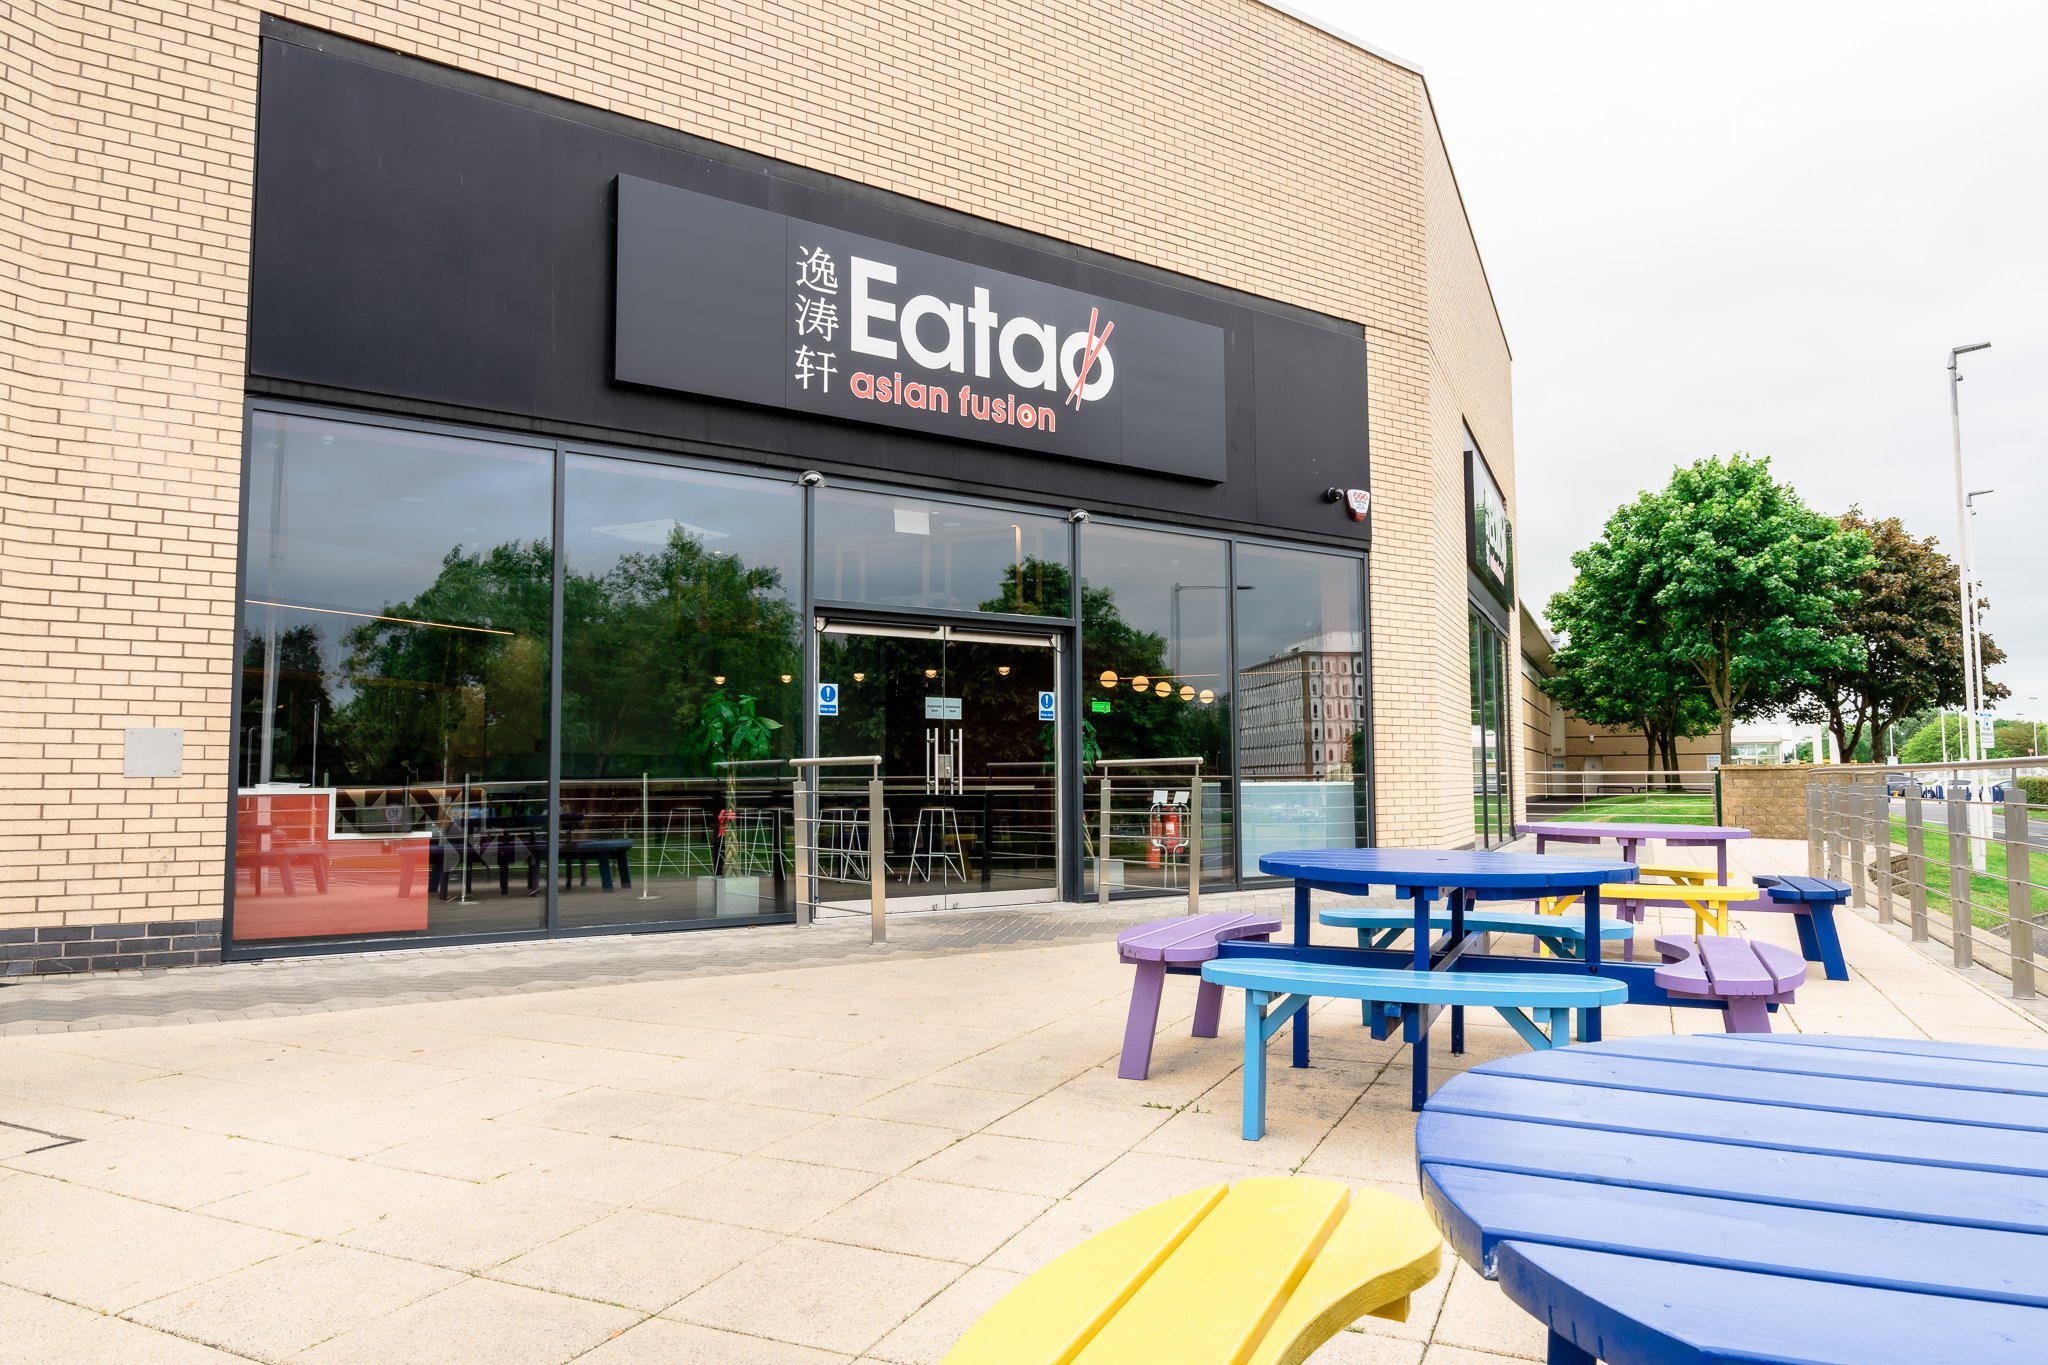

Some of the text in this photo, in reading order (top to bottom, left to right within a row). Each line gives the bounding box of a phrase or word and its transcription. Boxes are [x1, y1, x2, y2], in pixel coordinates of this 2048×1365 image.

[794, 245, 839, 393] 逸涛轩
[850, 256, 1115, 402] Eatao
[849, 371, 1056, 433] asian fusion
